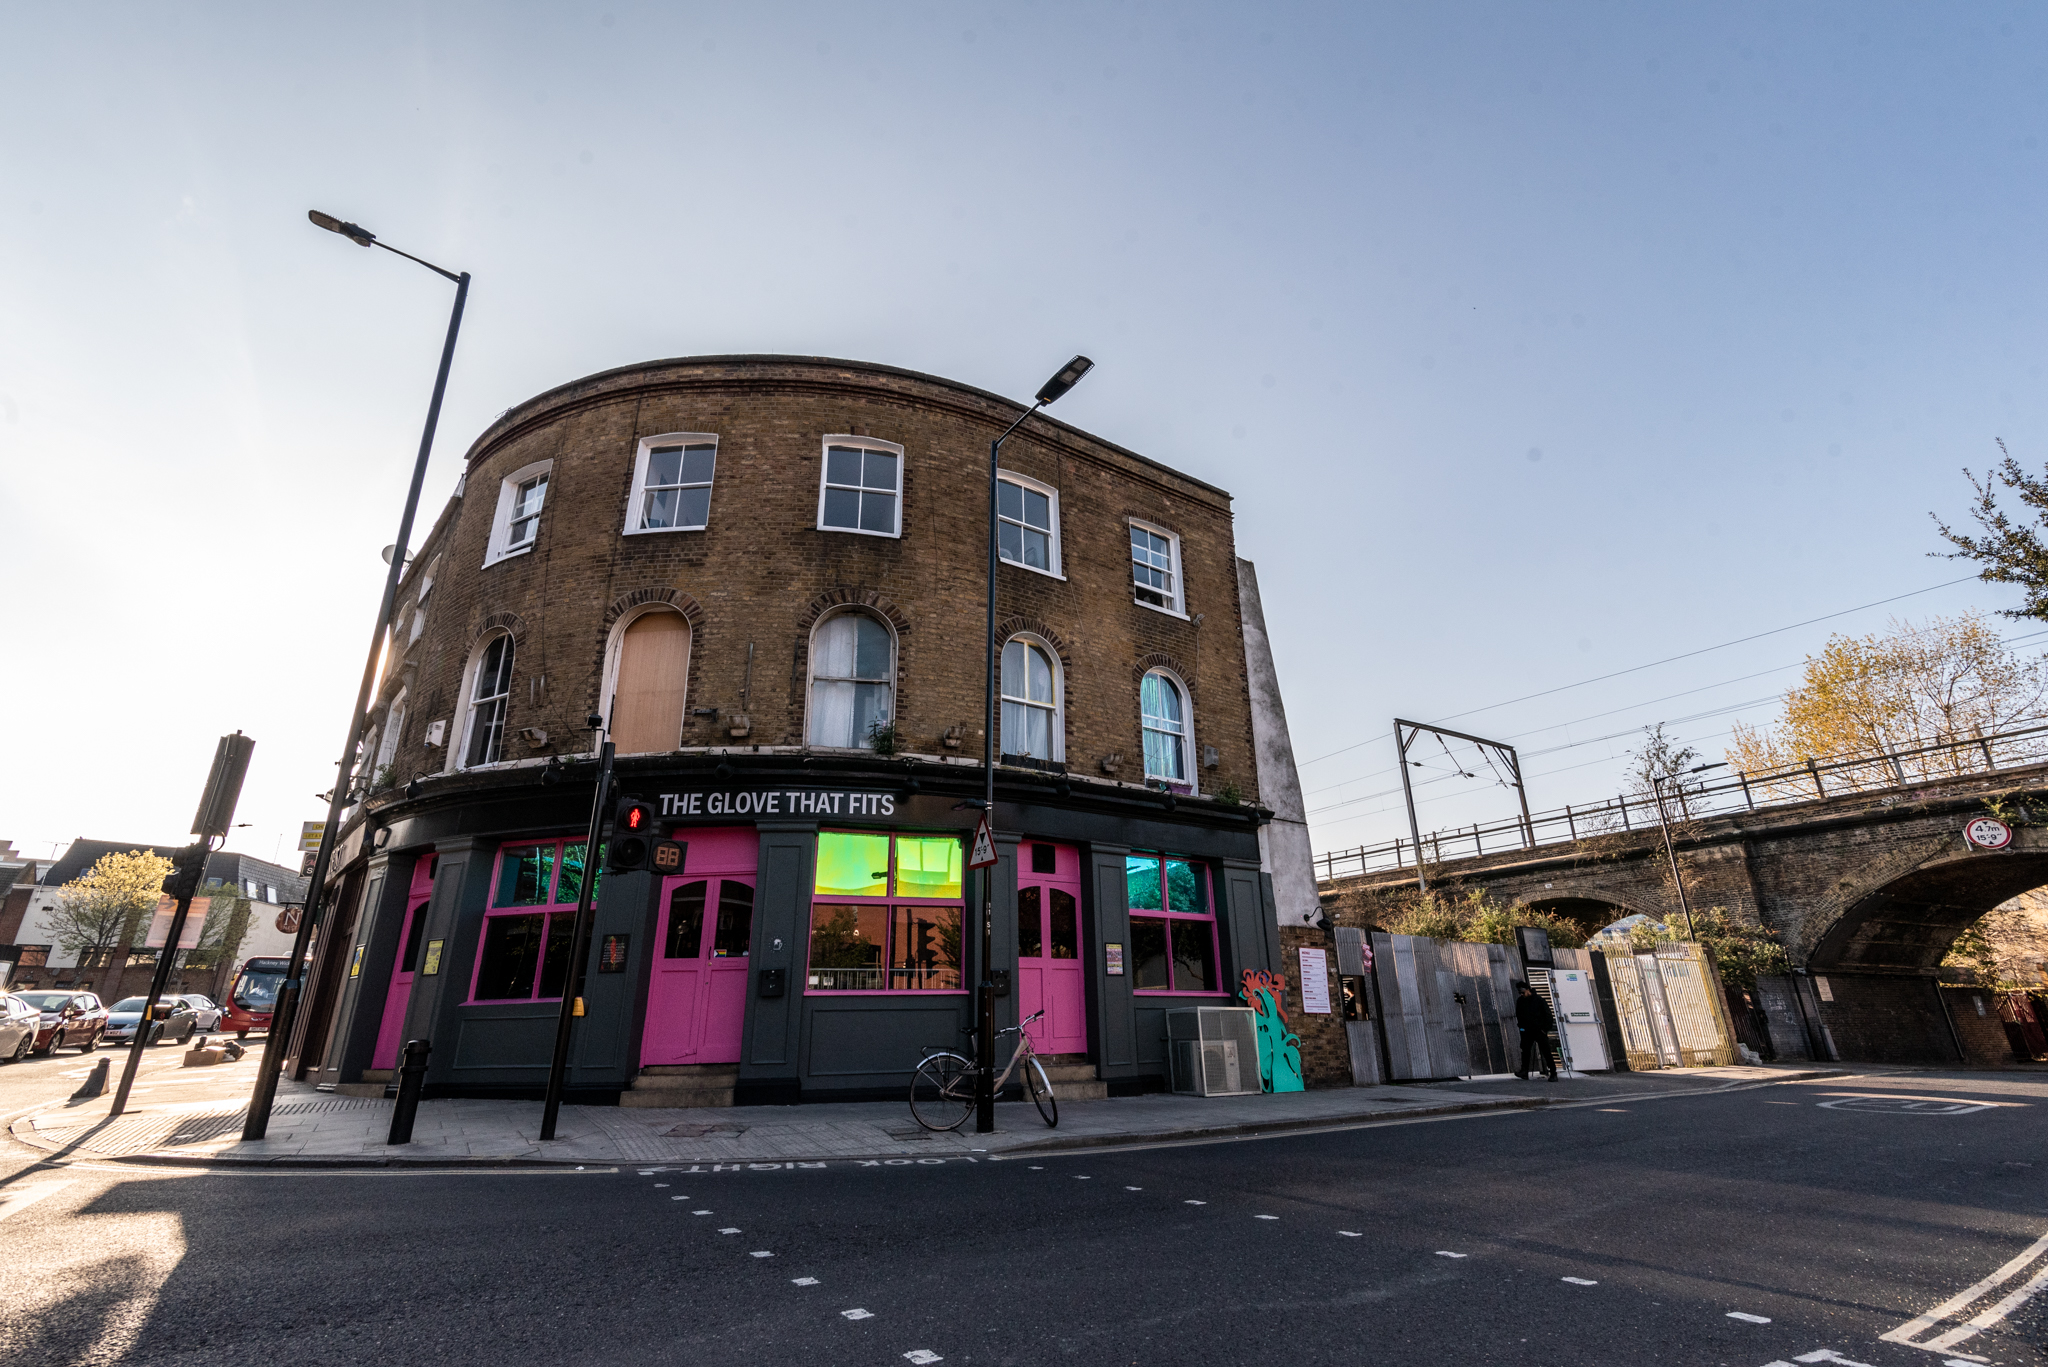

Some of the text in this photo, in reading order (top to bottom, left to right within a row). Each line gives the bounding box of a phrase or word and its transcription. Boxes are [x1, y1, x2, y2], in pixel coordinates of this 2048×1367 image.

[659, 791, 895, 816] THE GLOVE THAT FITS
